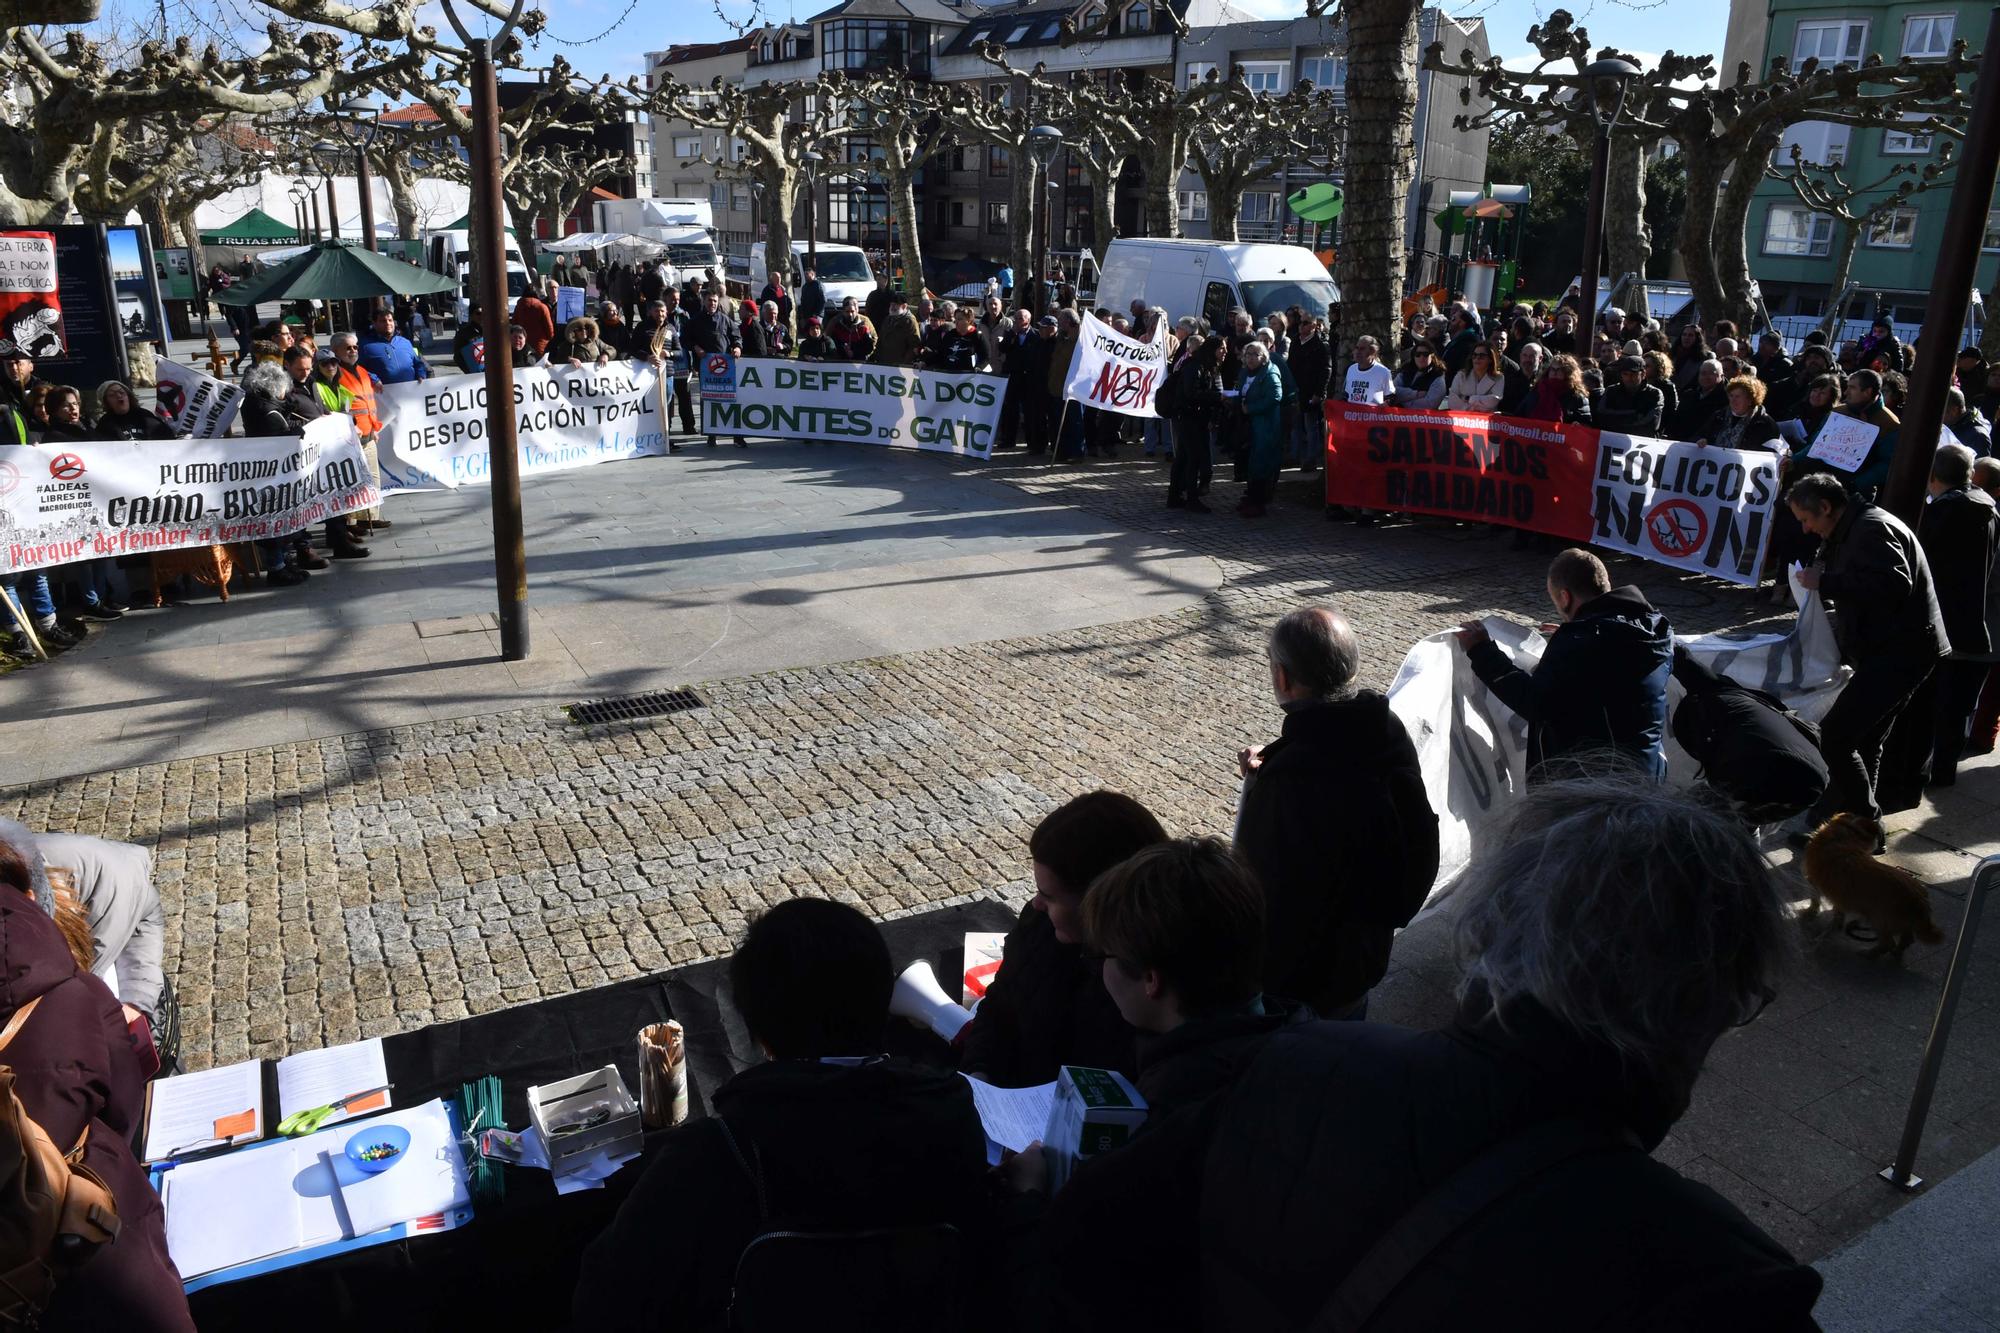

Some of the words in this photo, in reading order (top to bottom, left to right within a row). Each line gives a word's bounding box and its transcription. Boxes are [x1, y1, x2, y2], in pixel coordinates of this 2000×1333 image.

[16, 242, 48, 252] TERRA
[20, 261, 49, 270] NOM
[18, 275, 52, 288] EÓLICA
[425, 384, 524, 416] EÓLICS
[532, 380, 560, 402] NO
[568, 376, 640, 398] RURAL
[739, 367, 763, 388] A
[775, 368, 926, 400] DEFENSA
[935, 380, 996, 406] DOS
[1089, 362, 1158, 408] NON
[409, 404, 586, 452] DESPOACIÓN
[593, 396, 654, 424] TOTAL
[710, 402, 872, 436] MONTES
[878, 426, 900, 439] DO
[160, 458, 278, 486] PLATAFORMA
[524, 442, 588, 468] Veciños
[1368, 426, 1549, 480] SALVEMOS
[36, 482, 89, 493] #ALDEAS
[1598, 444, 1772, 506] EÓLICOS
[40, 494, 76, 504] LIBRES
[78, 492, 91, 500] DE
[1386, 468, 1534, 522] BALDAIO
[9, 538, 86, 568] Porque
[92, 527, 192, 554] defender
[220, 519, 267, 542] terra
[274, 518, 284, 533] e
